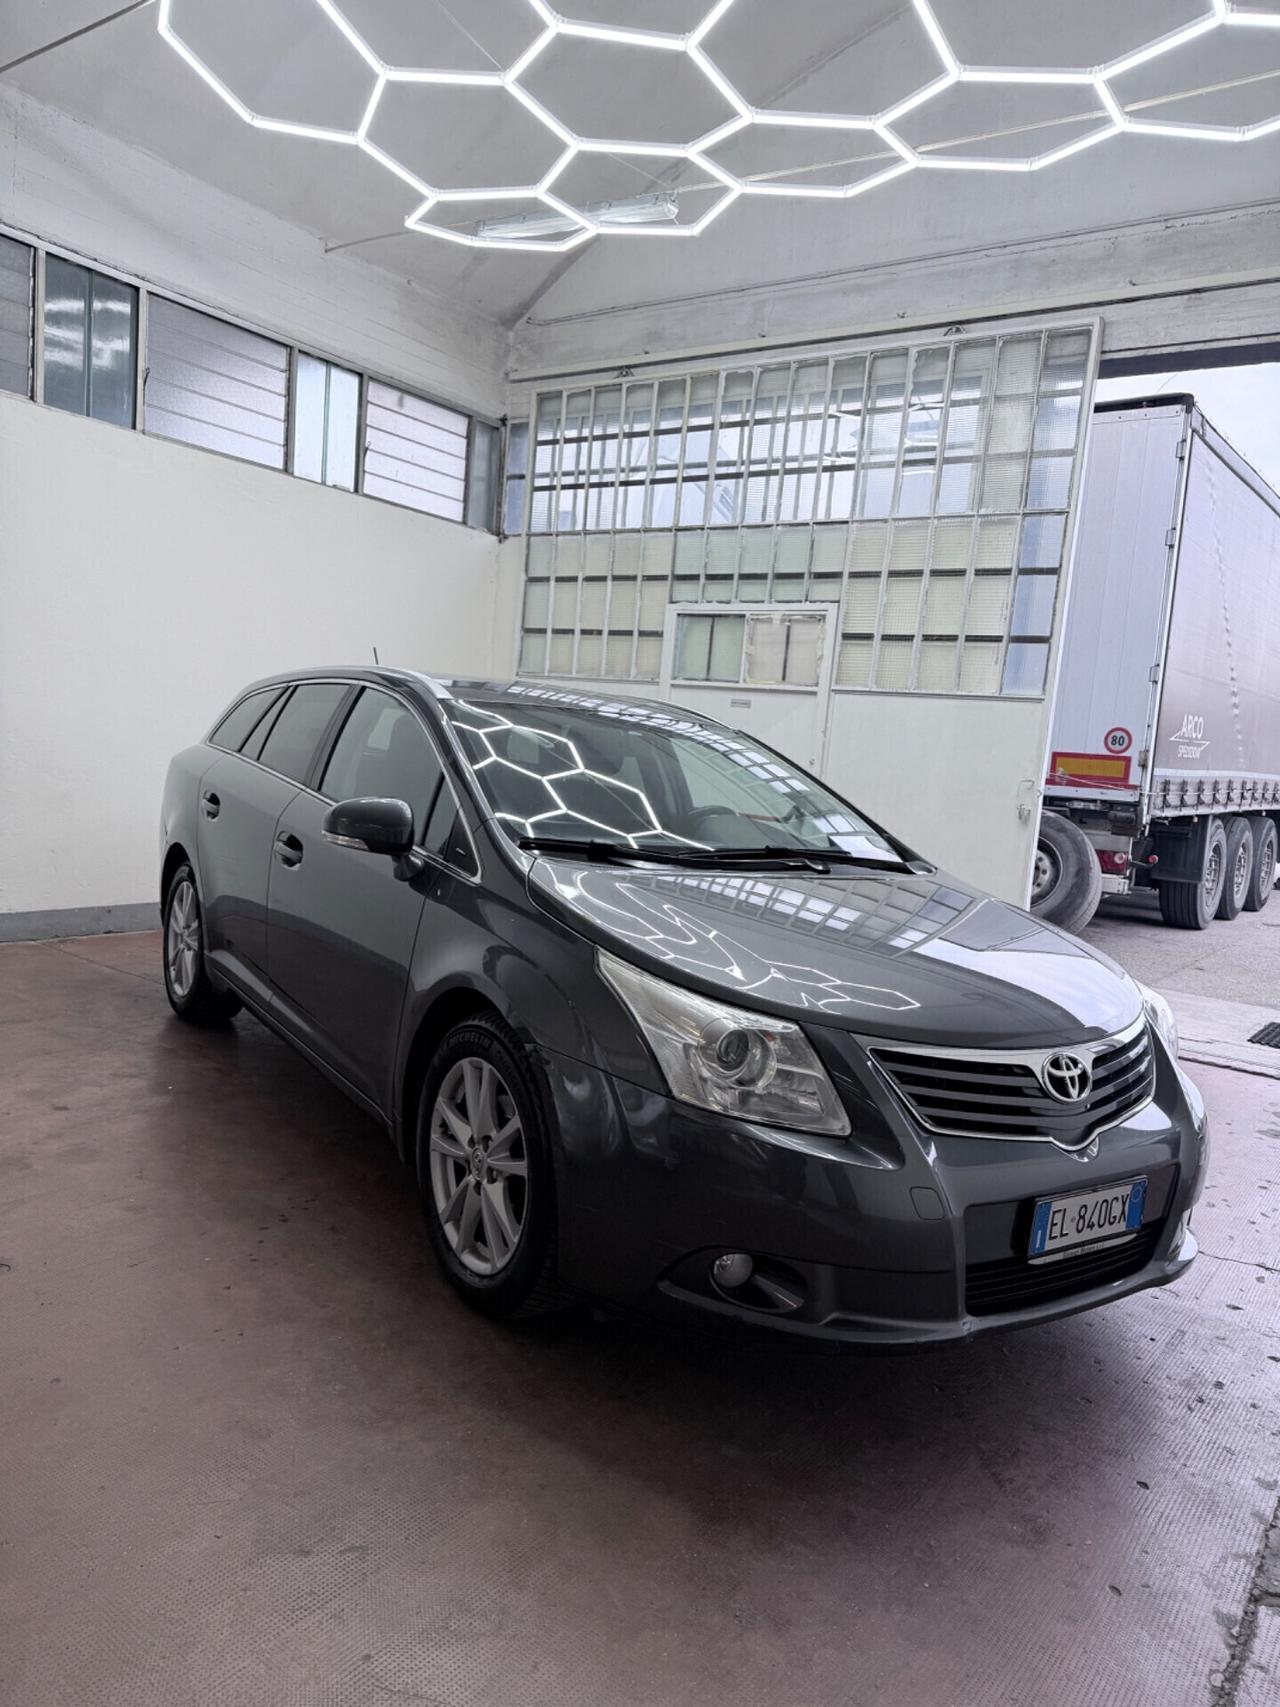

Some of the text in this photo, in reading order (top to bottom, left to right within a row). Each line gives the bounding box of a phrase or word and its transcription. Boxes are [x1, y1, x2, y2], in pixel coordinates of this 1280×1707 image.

[1180, 713, 1204, 739] ARCO
[1110, 734, 1126, 747] 80
[447, 1031, 490, 1049] MICHELIN
[1048, 1193, 1130, 1240] EL 840GX
